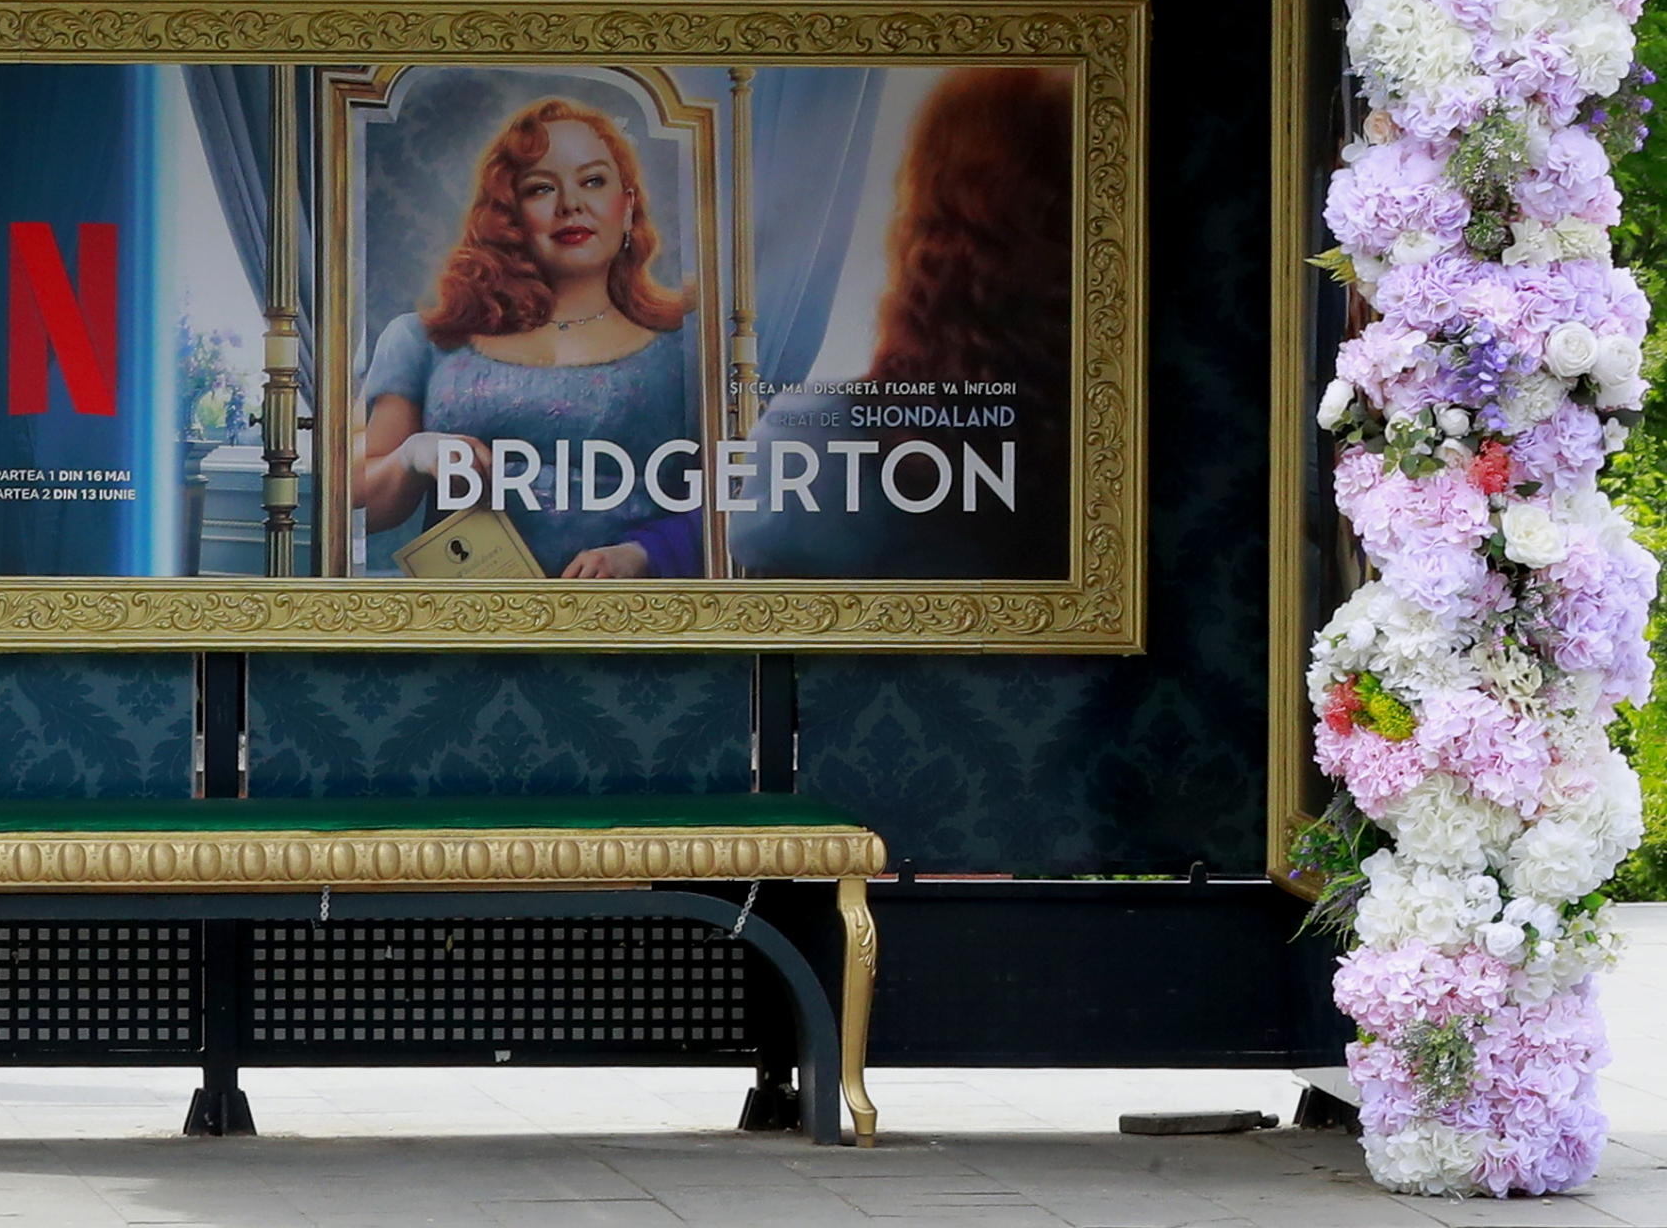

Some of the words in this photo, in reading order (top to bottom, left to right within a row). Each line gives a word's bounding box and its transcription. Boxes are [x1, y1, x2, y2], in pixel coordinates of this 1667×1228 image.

[8, 222, 118, 416] N
[749, 381, 776, 395] CEA
[782, 382, 808, 394] MAI
[814, 381, 879, 395] DISCRETĂ
[885, 382, 936, 395] FLOARE
[942, 382, 958, 395] VA
[964, 379, 1017, 395] ÎNFLORI
[770, 412, 817, 427] REAT
[820, 412, 840, 427] DE
[850, 405, 1015, 428] SHONDALAND
[49, 470, 55, 481] 1
[59, 470, 84, 481] DIN
[87, 470, 103, 481] 16
[105, 470, 131, 481] MAI
[436, 439, 1016, 513] BRIDGERTON
[42, 489, 51, 500] 2
[54, 489, 78, 500] DIN
[81, 489, 97, 500] 13
[99, 489, 137, 500] IUNIE
